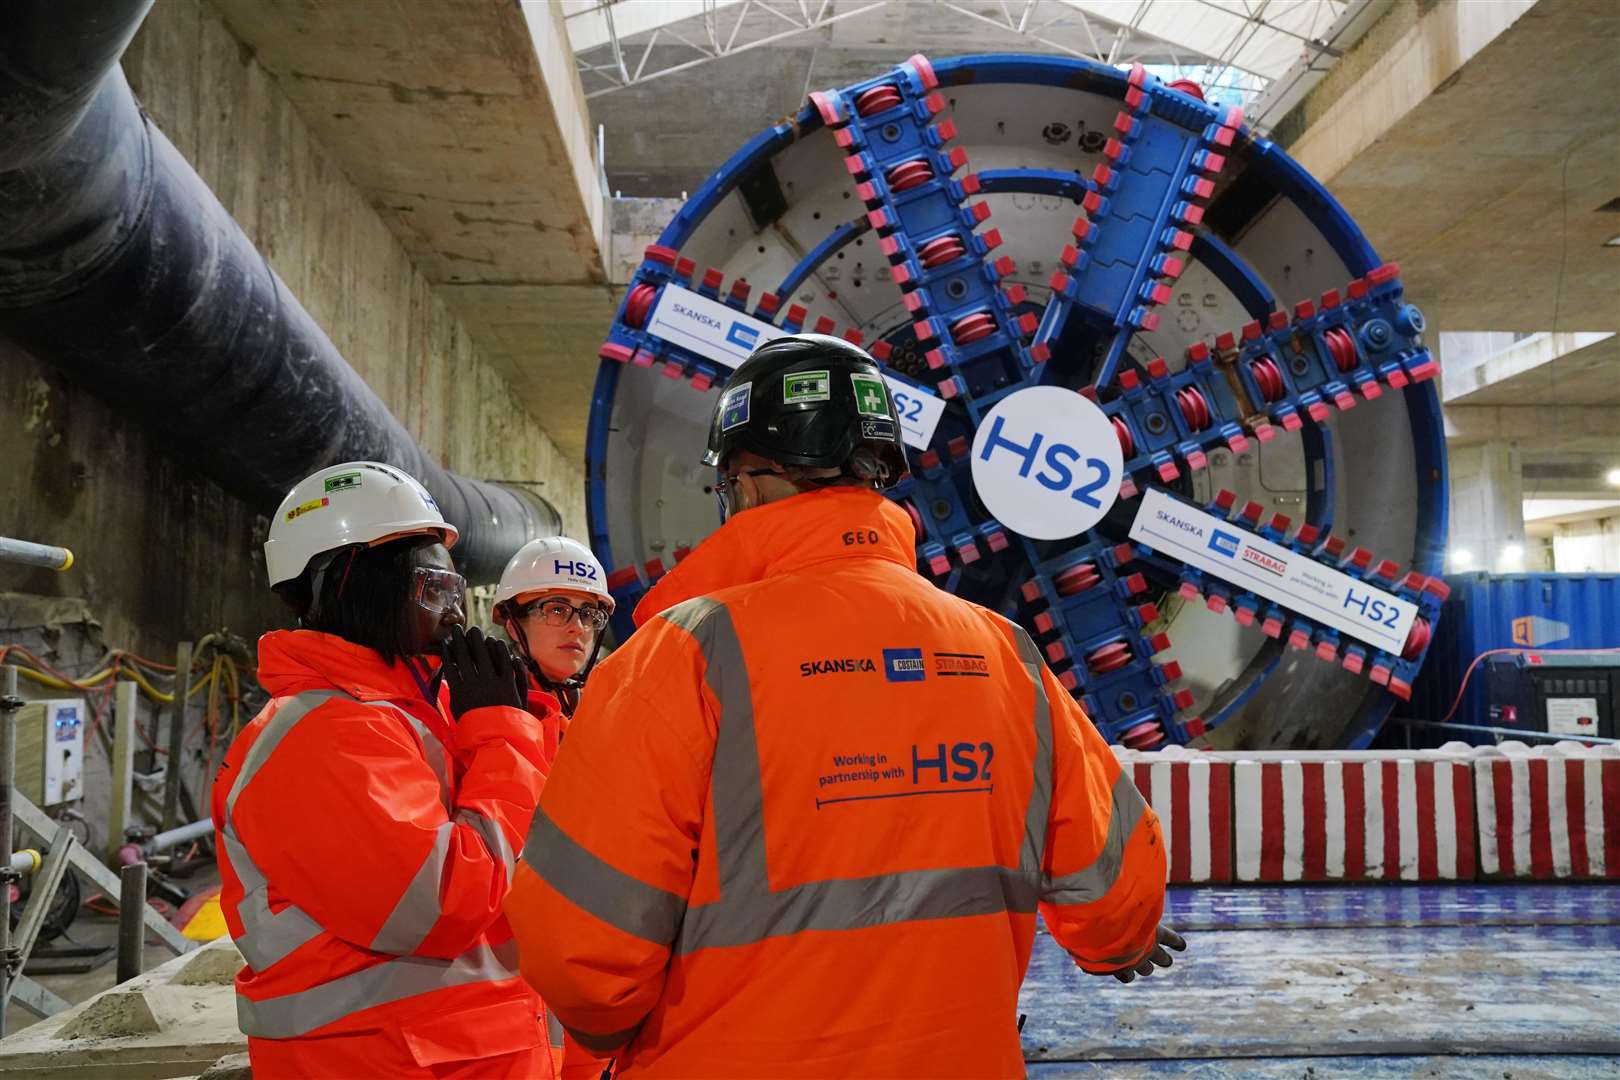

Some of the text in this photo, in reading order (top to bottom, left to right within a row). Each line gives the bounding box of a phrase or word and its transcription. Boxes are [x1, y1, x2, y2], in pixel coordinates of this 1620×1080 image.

[673, 303, 722, 330] SKANSKA
[891, 389, 923, 422] S2
[980, 415, 1111, 509] HS2
[1156, 510, 1203, 537] SKANSKA
[842, 530, 879, 546] GEO
[554, 559, 597, 581] HS2
[1242, 548, 1287, 574] STRABAG
[1344, 588, 1401, 629] HS2
[800, 658, 877, 677] SKANSKA
[898, 659, 924, 670] COSTAIN
[935, 658, 987, 671] STRABAG
[833, 753, 887, 767] Working in
[912, 742, 994, 785] HS2
[819, 767, 905, 787] partnership with
